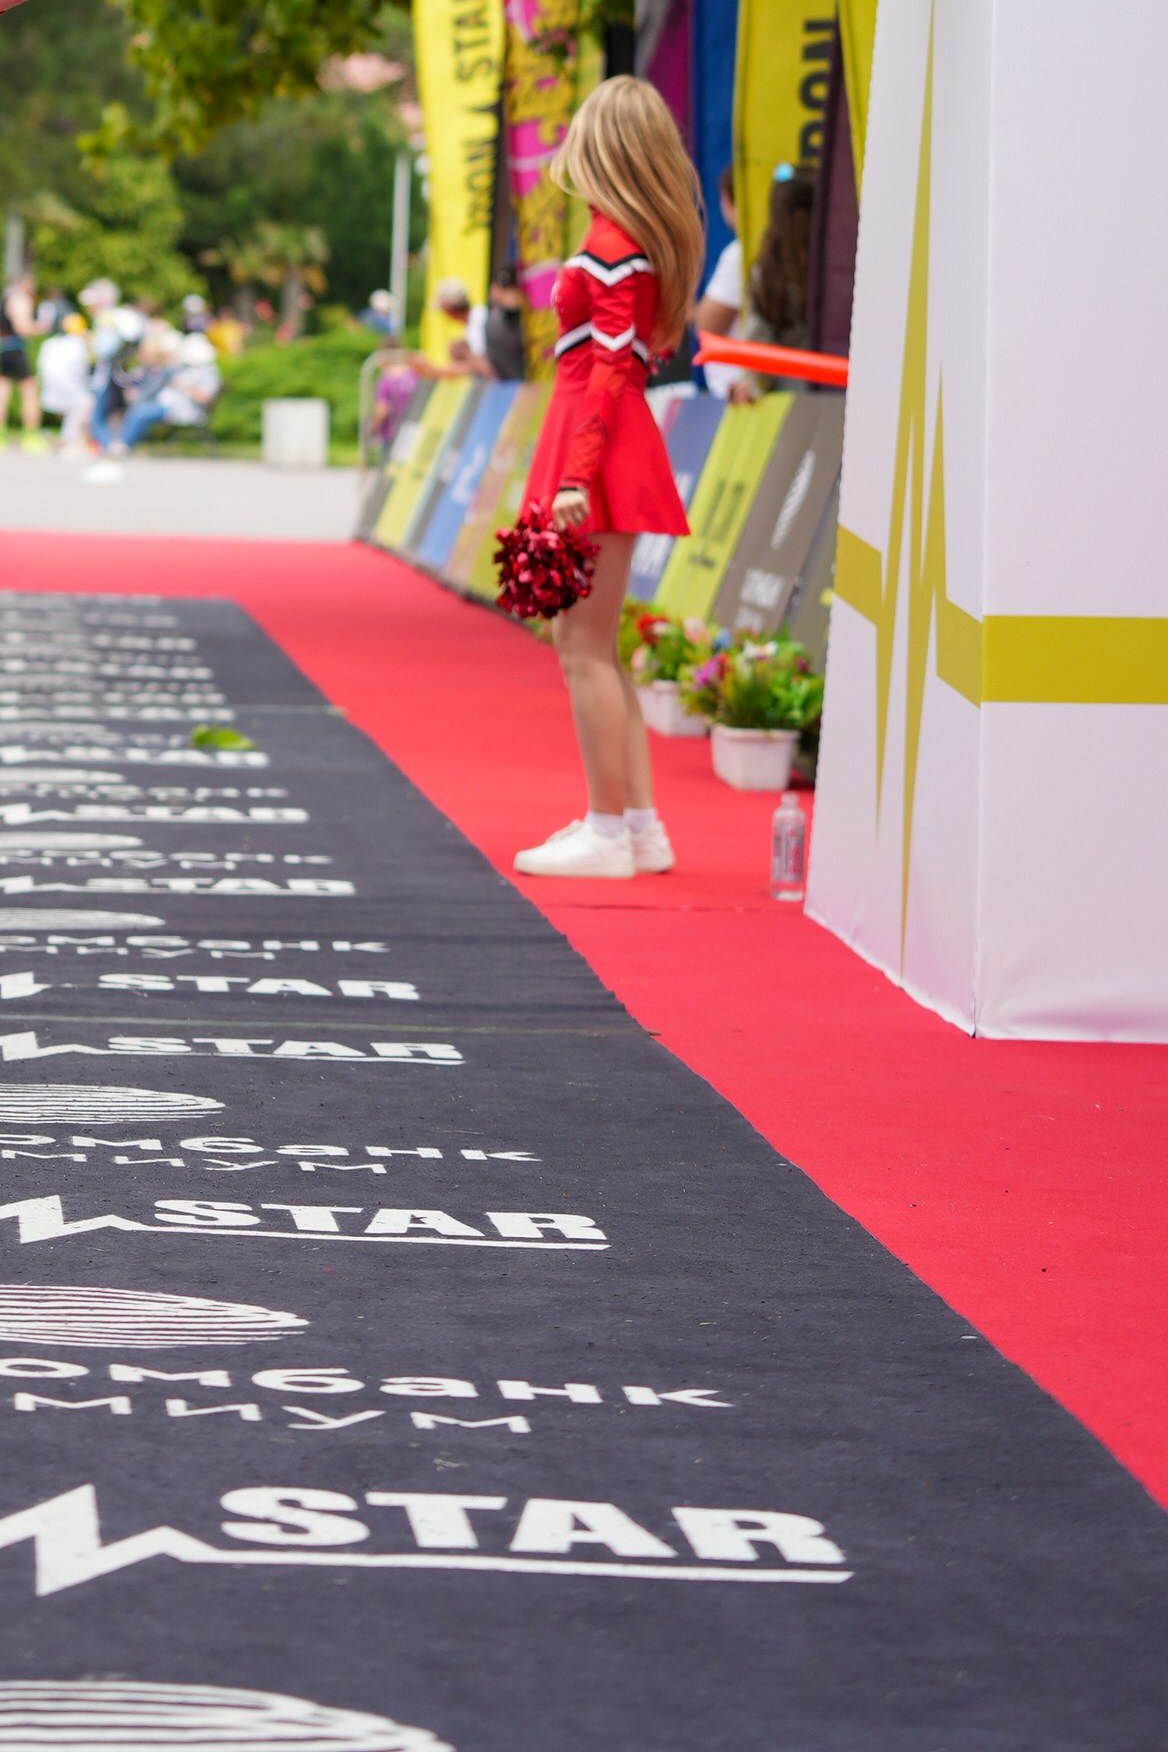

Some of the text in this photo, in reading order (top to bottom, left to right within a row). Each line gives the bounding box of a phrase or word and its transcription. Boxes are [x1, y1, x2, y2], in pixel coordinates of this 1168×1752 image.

[99, 973, 421, 1001] STAR
[108, 1036, 464, 1060] STAR
[154, 1199, 609, 1241] STAR
[220, 1486, 848, 1564] STAR
